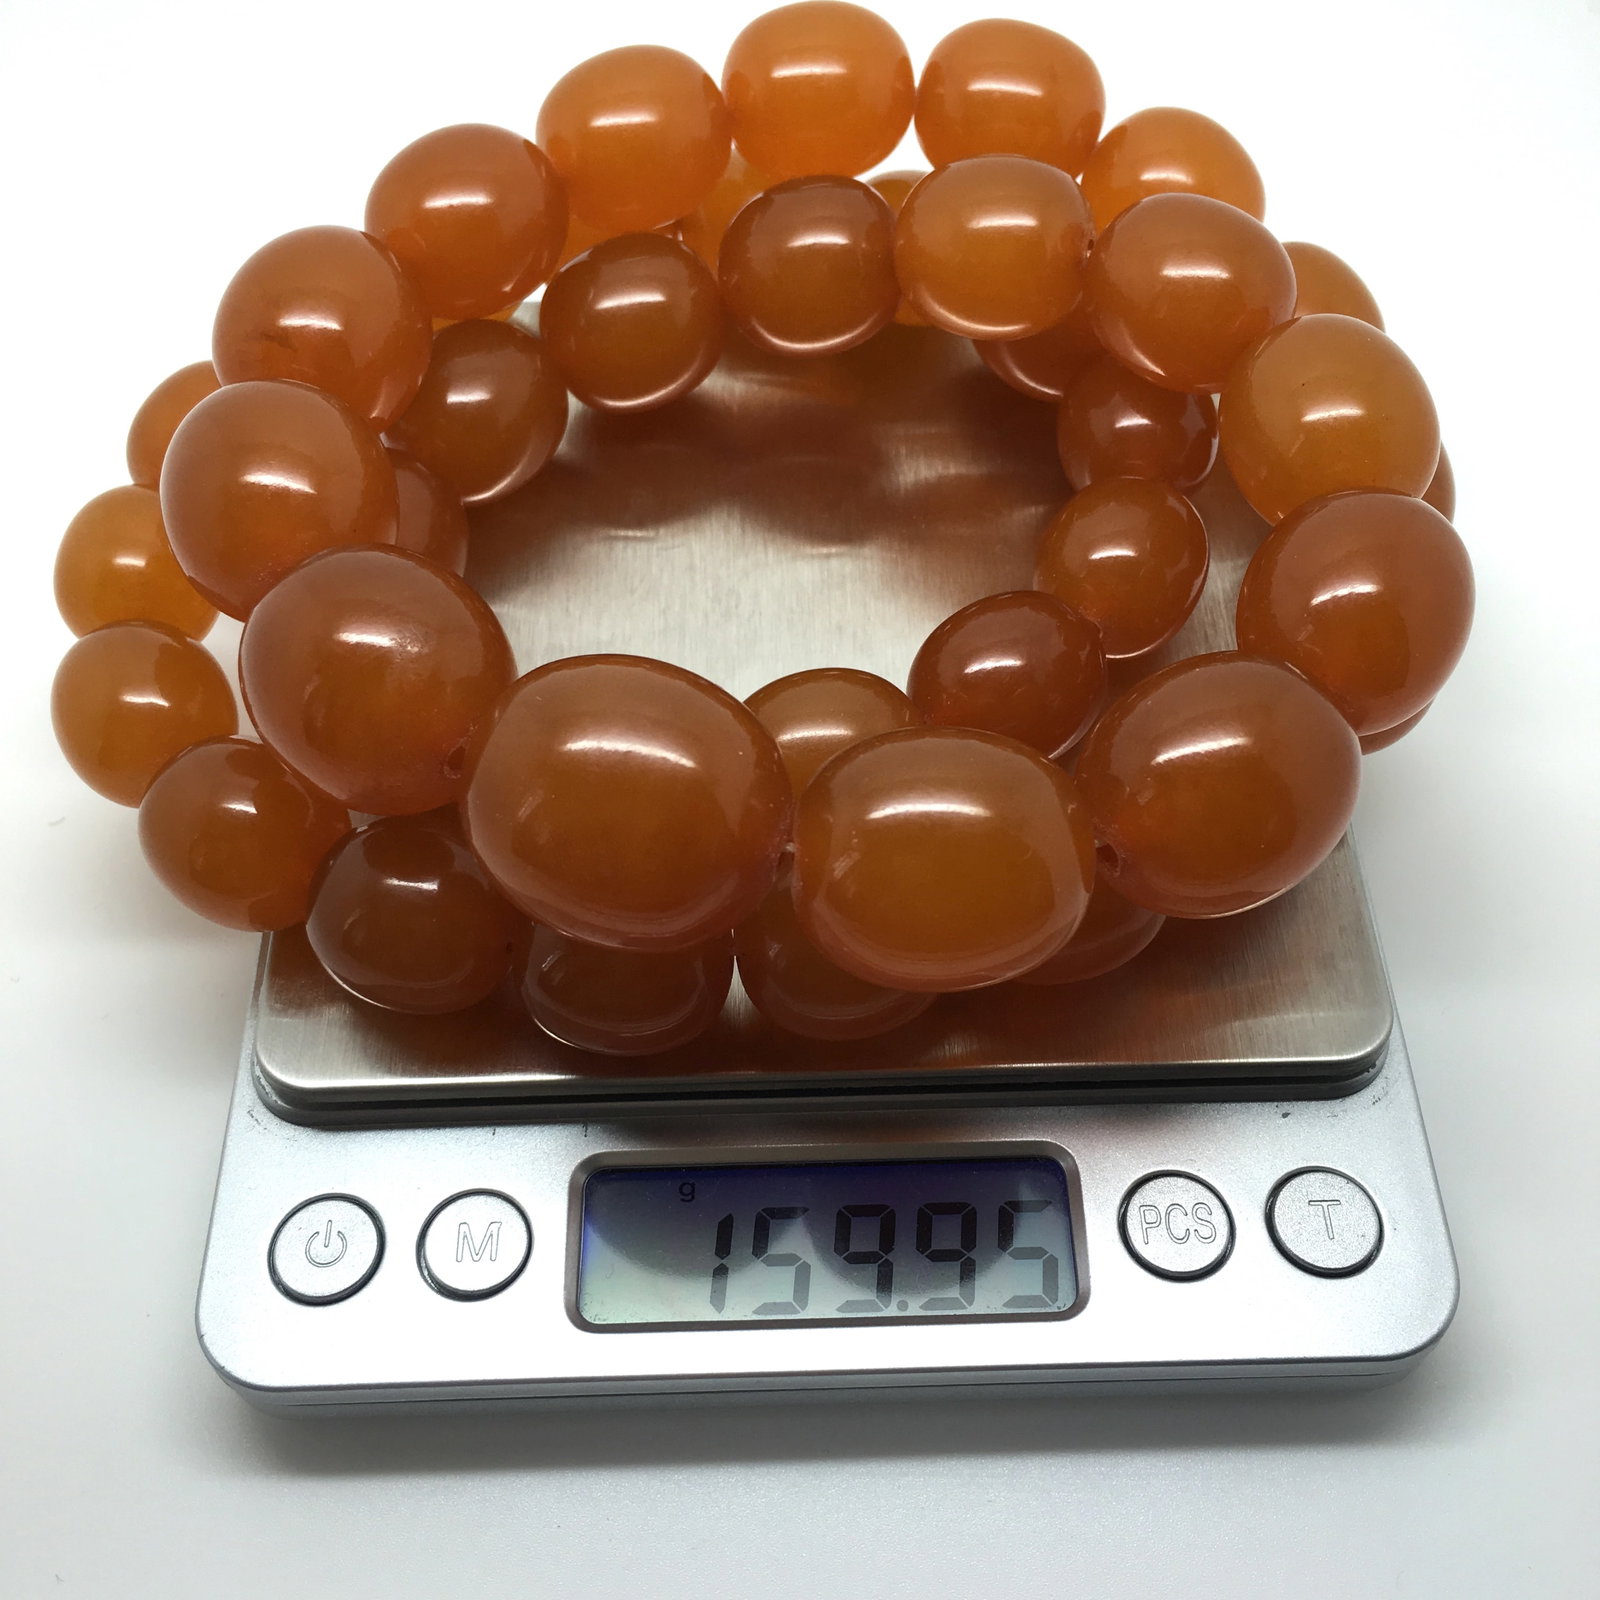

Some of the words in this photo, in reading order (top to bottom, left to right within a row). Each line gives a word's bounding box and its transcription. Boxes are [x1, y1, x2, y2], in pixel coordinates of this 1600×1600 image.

[678, 1180, 696, 1202] g
[1138, 1202, 1217, 1245] PCS
[1307, 1199, 1342, 1240] T
[455, 1221, 503, 1263] M
[708, 1199, 1060, 1316] 159.95
